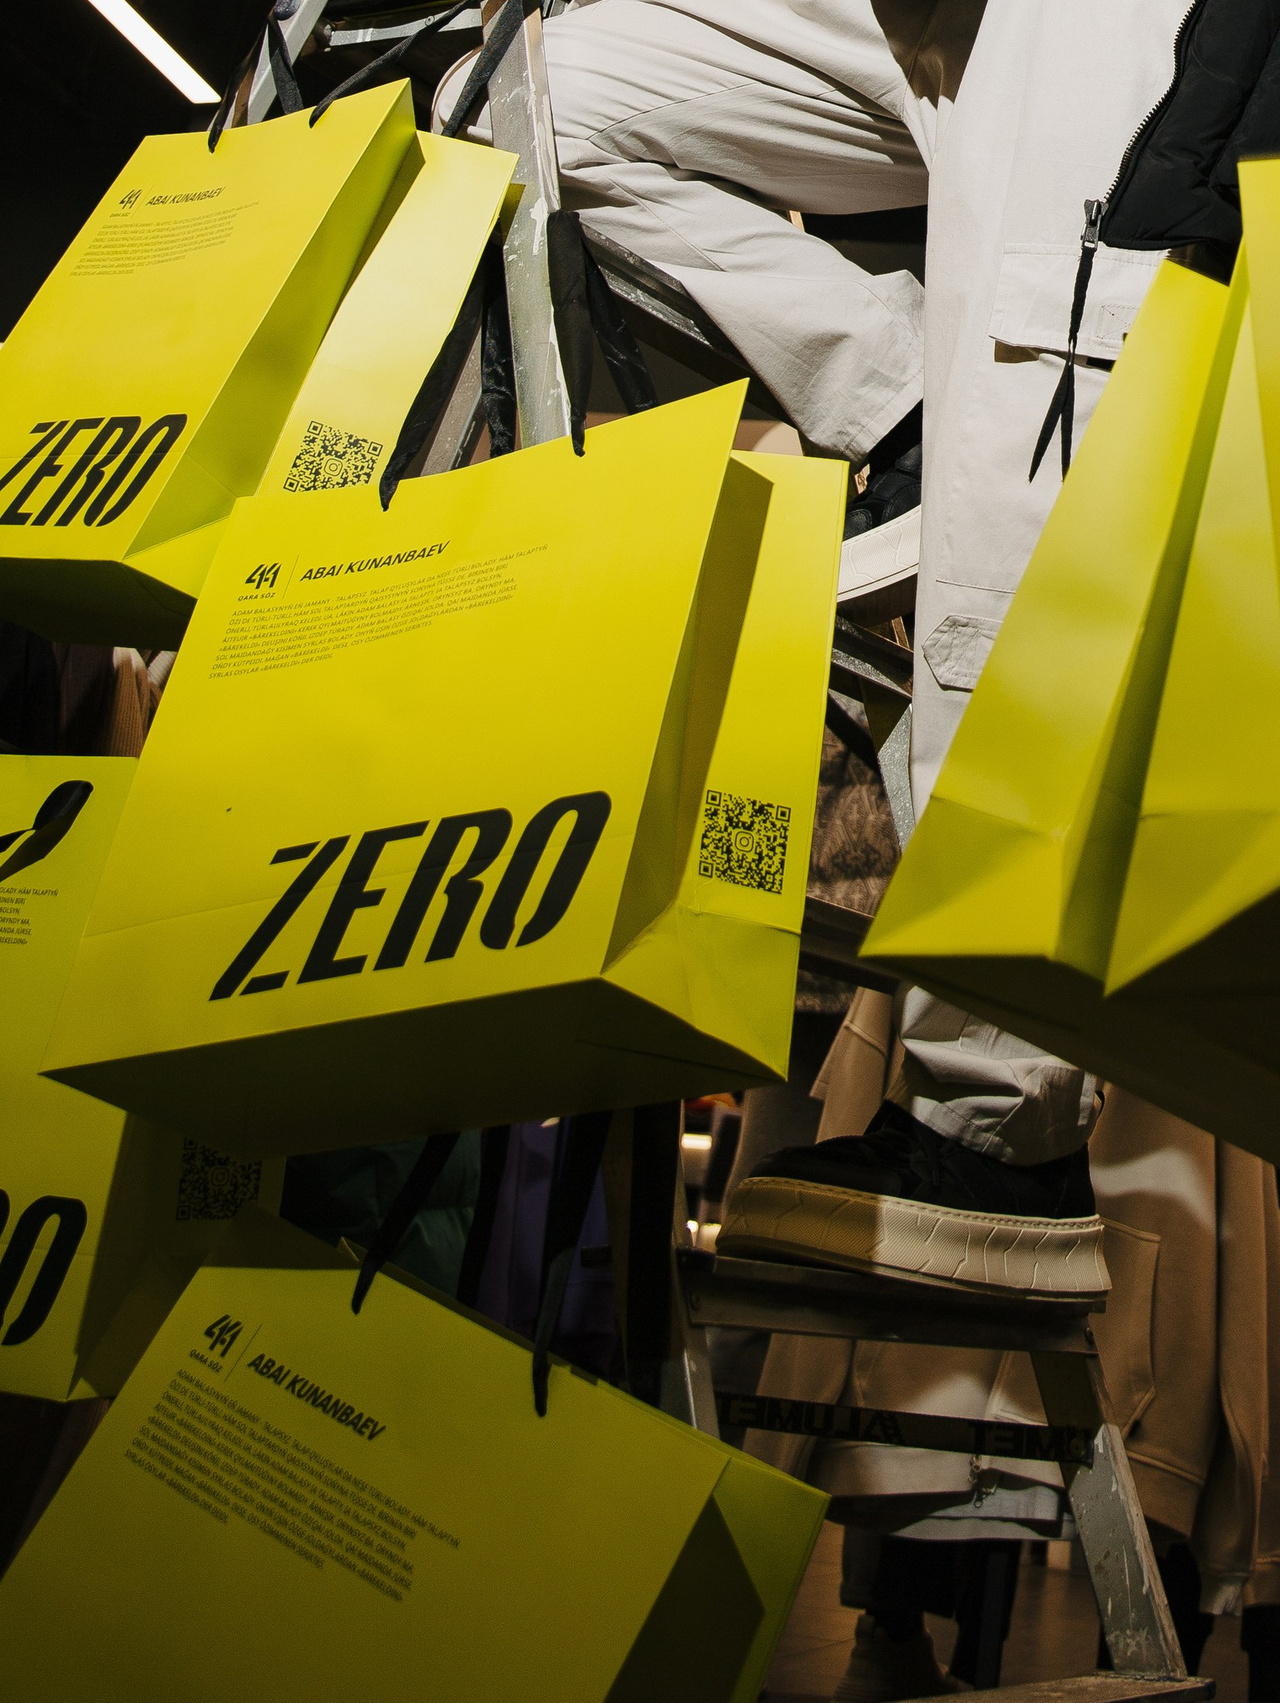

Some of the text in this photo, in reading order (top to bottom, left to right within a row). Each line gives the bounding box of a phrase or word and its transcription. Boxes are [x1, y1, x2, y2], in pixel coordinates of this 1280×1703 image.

[146, 195, 170, 206] ABAI
[0, 413, 188, 527] ZERO
[300, 563, 343, 581] ABAI
[344, 540, 451, 575] KUNANBAEV
[209, 791, 613, 1002] ZERO
[248, 1353, 291, 1388] ABAI
[287, 1376, 387, 1442] KUNANBAEV
